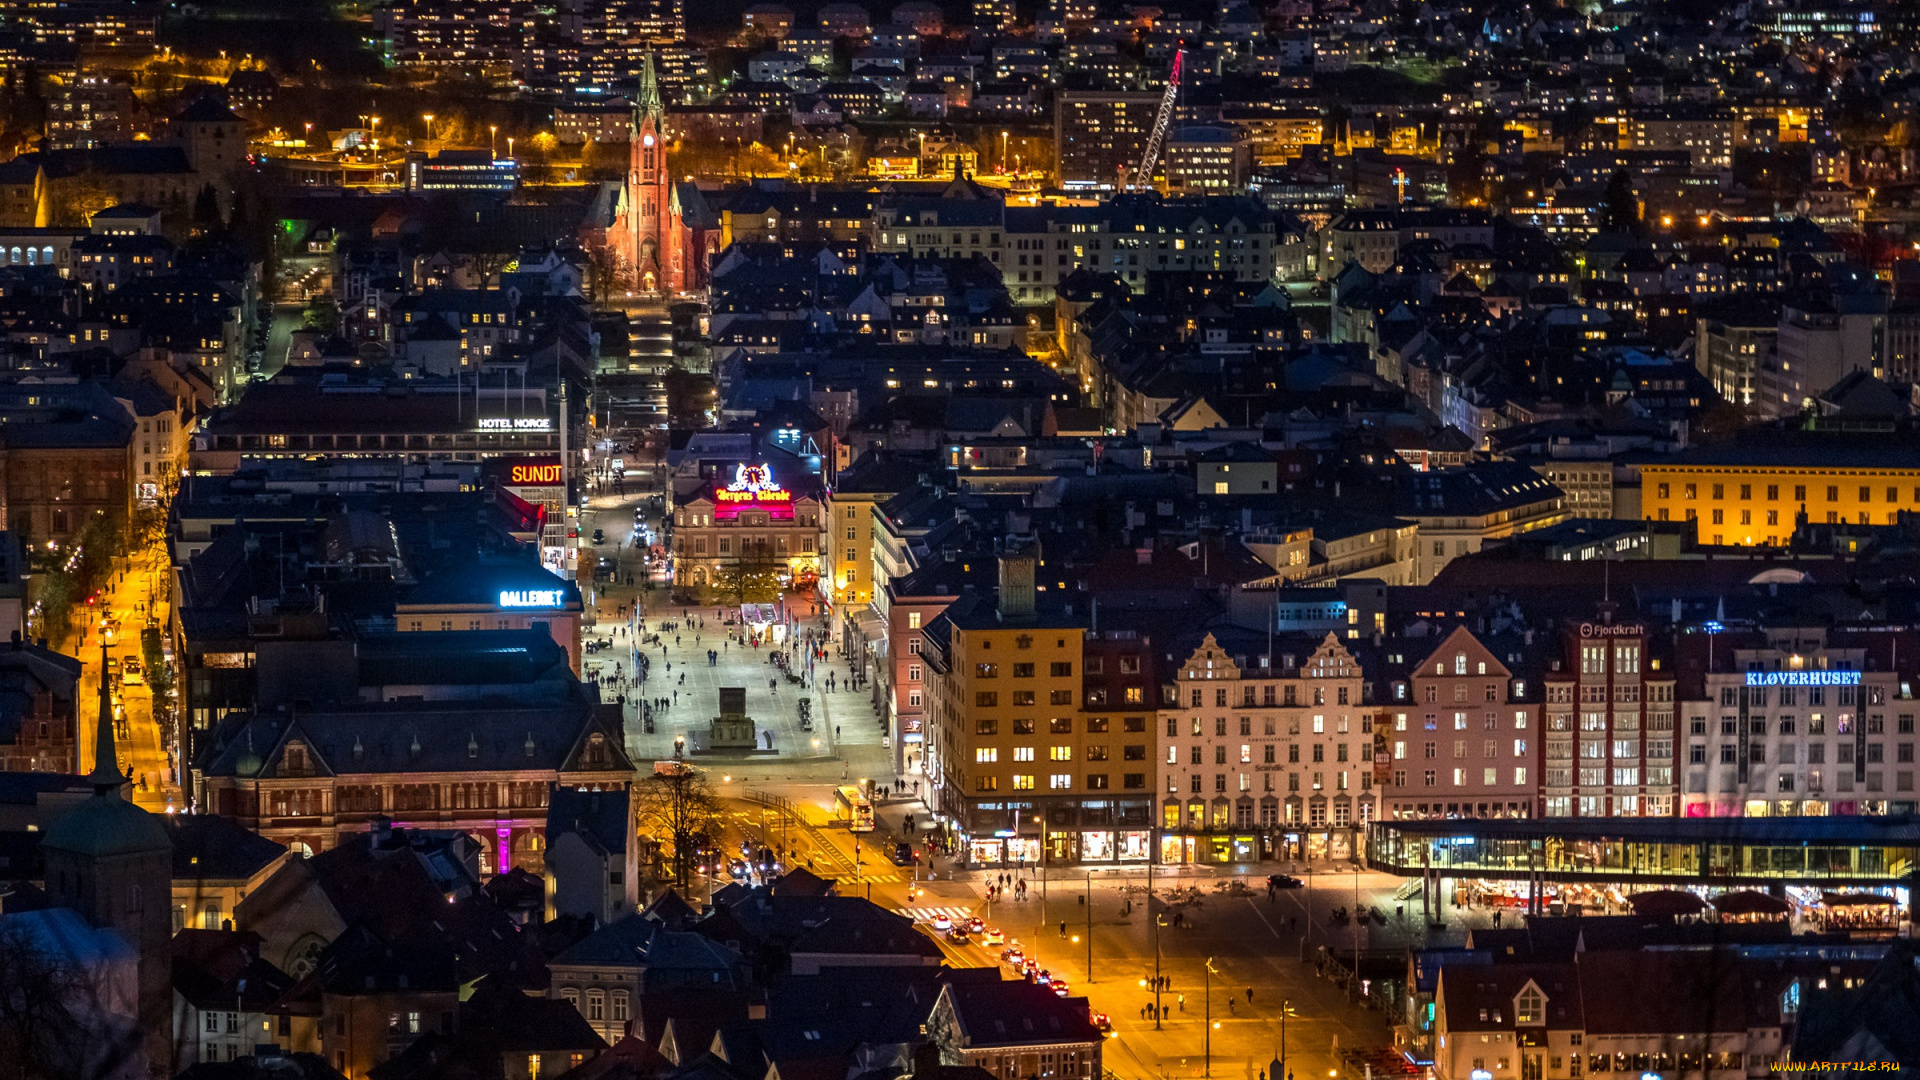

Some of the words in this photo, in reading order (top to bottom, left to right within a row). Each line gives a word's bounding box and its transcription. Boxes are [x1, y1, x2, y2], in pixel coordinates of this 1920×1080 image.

[478, 418, 512, 428] HOTEL
[514, 418, 550, 428] NORGE
[511, 464, 563, 483] SUNDT
[716, 489, 753, 503] Bergens
[756, 489, 791, 501] Tidende
[499, 590, 564, 607] GALLERIET
[1594, 623, 1644, 637] Fjordkraft
[1745, 671, 1862, 686] KLØVERHUSET
[1254, 764, 1285, 773] Scandic
